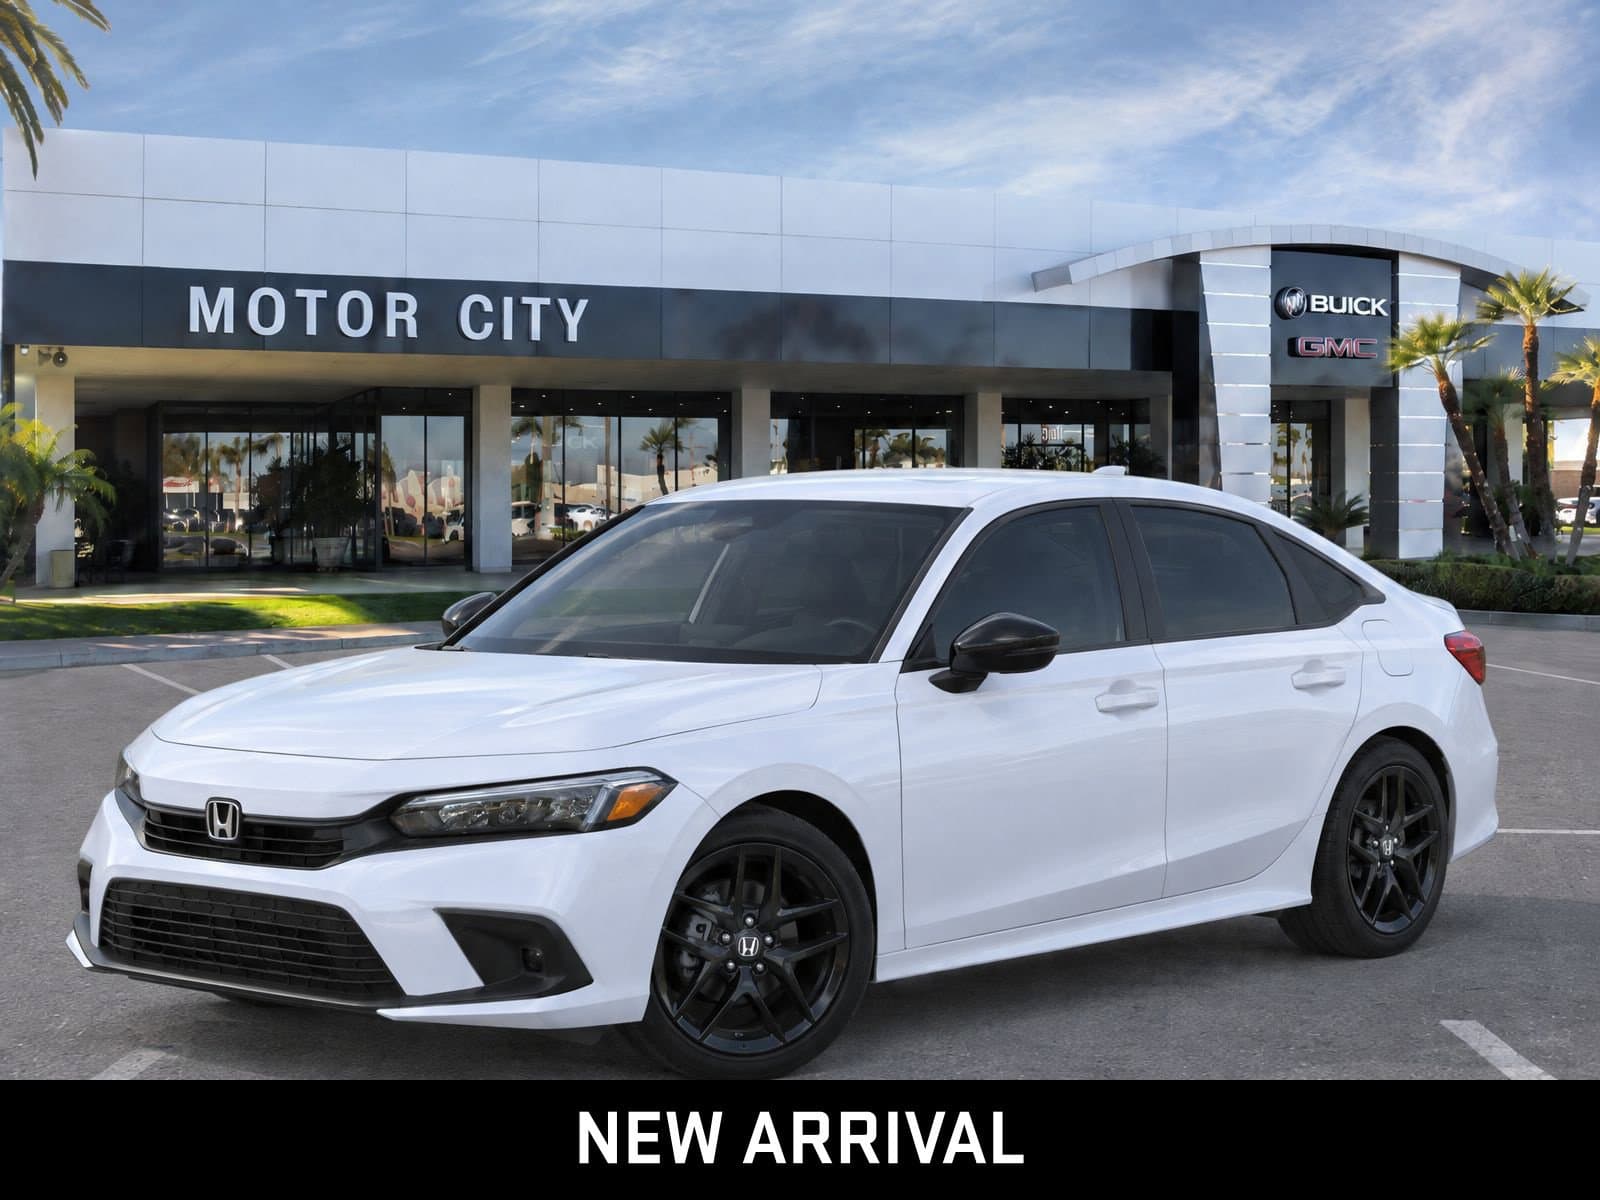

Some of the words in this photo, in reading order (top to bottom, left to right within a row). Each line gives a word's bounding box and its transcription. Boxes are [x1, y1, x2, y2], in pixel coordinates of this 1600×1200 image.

[189, 286, 418, 338] MOTOR
[459, 294, 589, 342] CITY
[1310, 294, 1388, 317] BUICK
[1297, 336, 1378, 358] GMC
